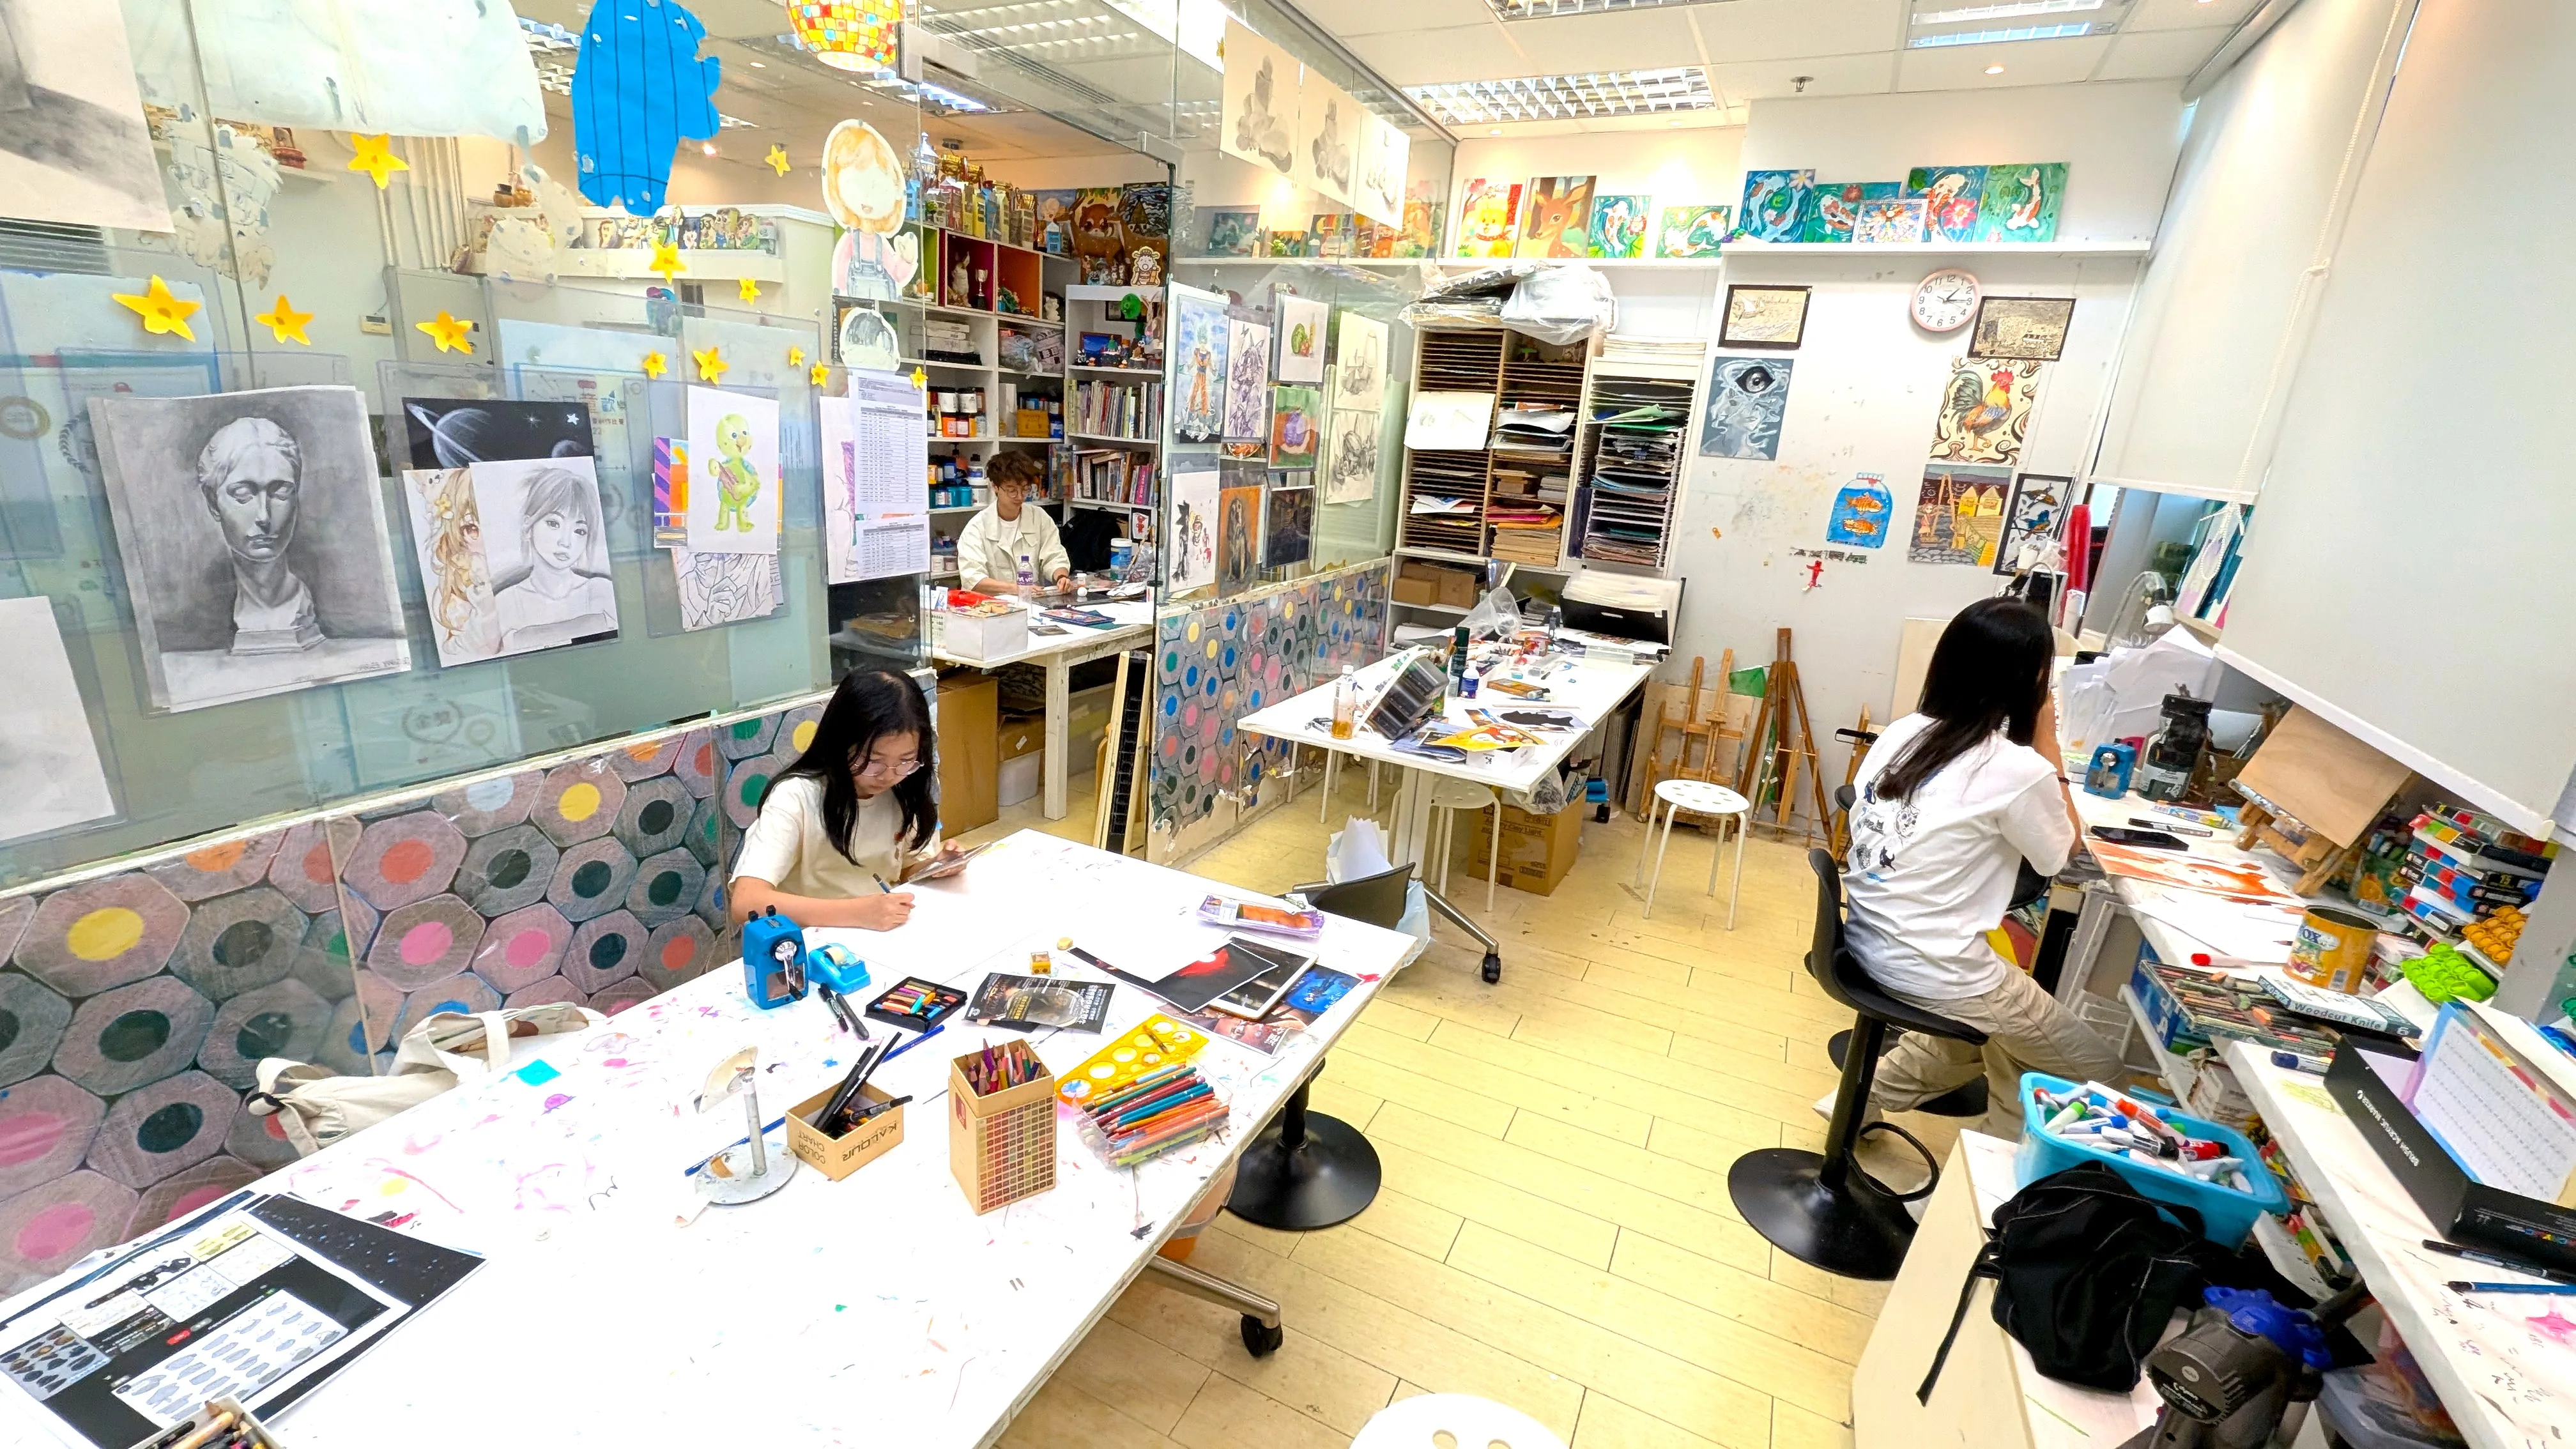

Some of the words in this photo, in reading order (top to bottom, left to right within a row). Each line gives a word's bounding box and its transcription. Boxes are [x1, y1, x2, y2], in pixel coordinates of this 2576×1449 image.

[1935, 277, 1943, 286] 11
[1947, 274, 1956, 283] 12
[1924, 285, 1933, 294] 10
[1965, 286, 1973, 295] 2
[1918, 296, 1925, 305] 9
[1966, 297, 1973, 306] 3
[1919, 307, 1926, 316] 8
[1960, 308, 1966, 317] 4
[1926, 315, 1933, 323] 7
[1936, 318, 1943, 327] 6
[1949, 316, 1956, 325] 5
[2294, 1002, 2349, 1022] Woodcut
[2350, 1016, 2382, 1030] Knife
[798, 1130, 825, 1152] CHART
[842, 1123, 898, 1162] KALOUR
[799, 1141, 826, 1165] COLOR
